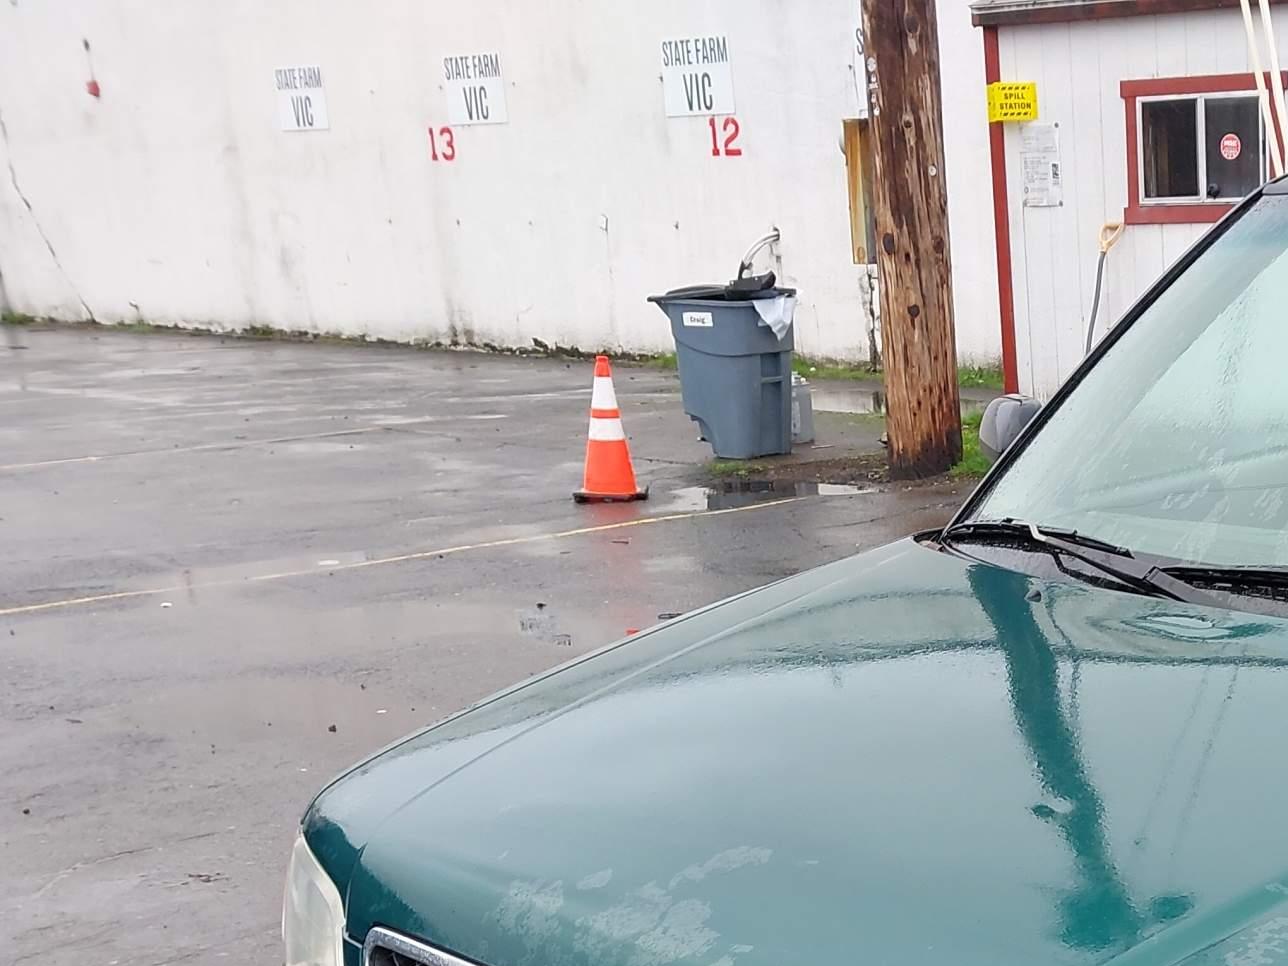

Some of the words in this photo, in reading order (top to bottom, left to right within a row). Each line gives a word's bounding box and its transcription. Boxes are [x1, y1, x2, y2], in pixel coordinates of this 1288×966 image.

[443, 56, 471, 81] STATE
[471, 53, 501, 79] FARM
[662, 39, 693, 67] STATE
[694, 36, 728, 65] FARM
[275, 68, 298, 90] STATE
[298, 66, 322, 89] FARM
[683, 71, 713, 111] VIC
[291, 96, 314, 127] VIC
[463, 85, 489, 121] VIC
[999, 102, 1032, 110] STATION
[1004, 92, 1025, 100] SPILL
[428, 126, 456, 161] 13
[708, 117, 742, 156] 12
